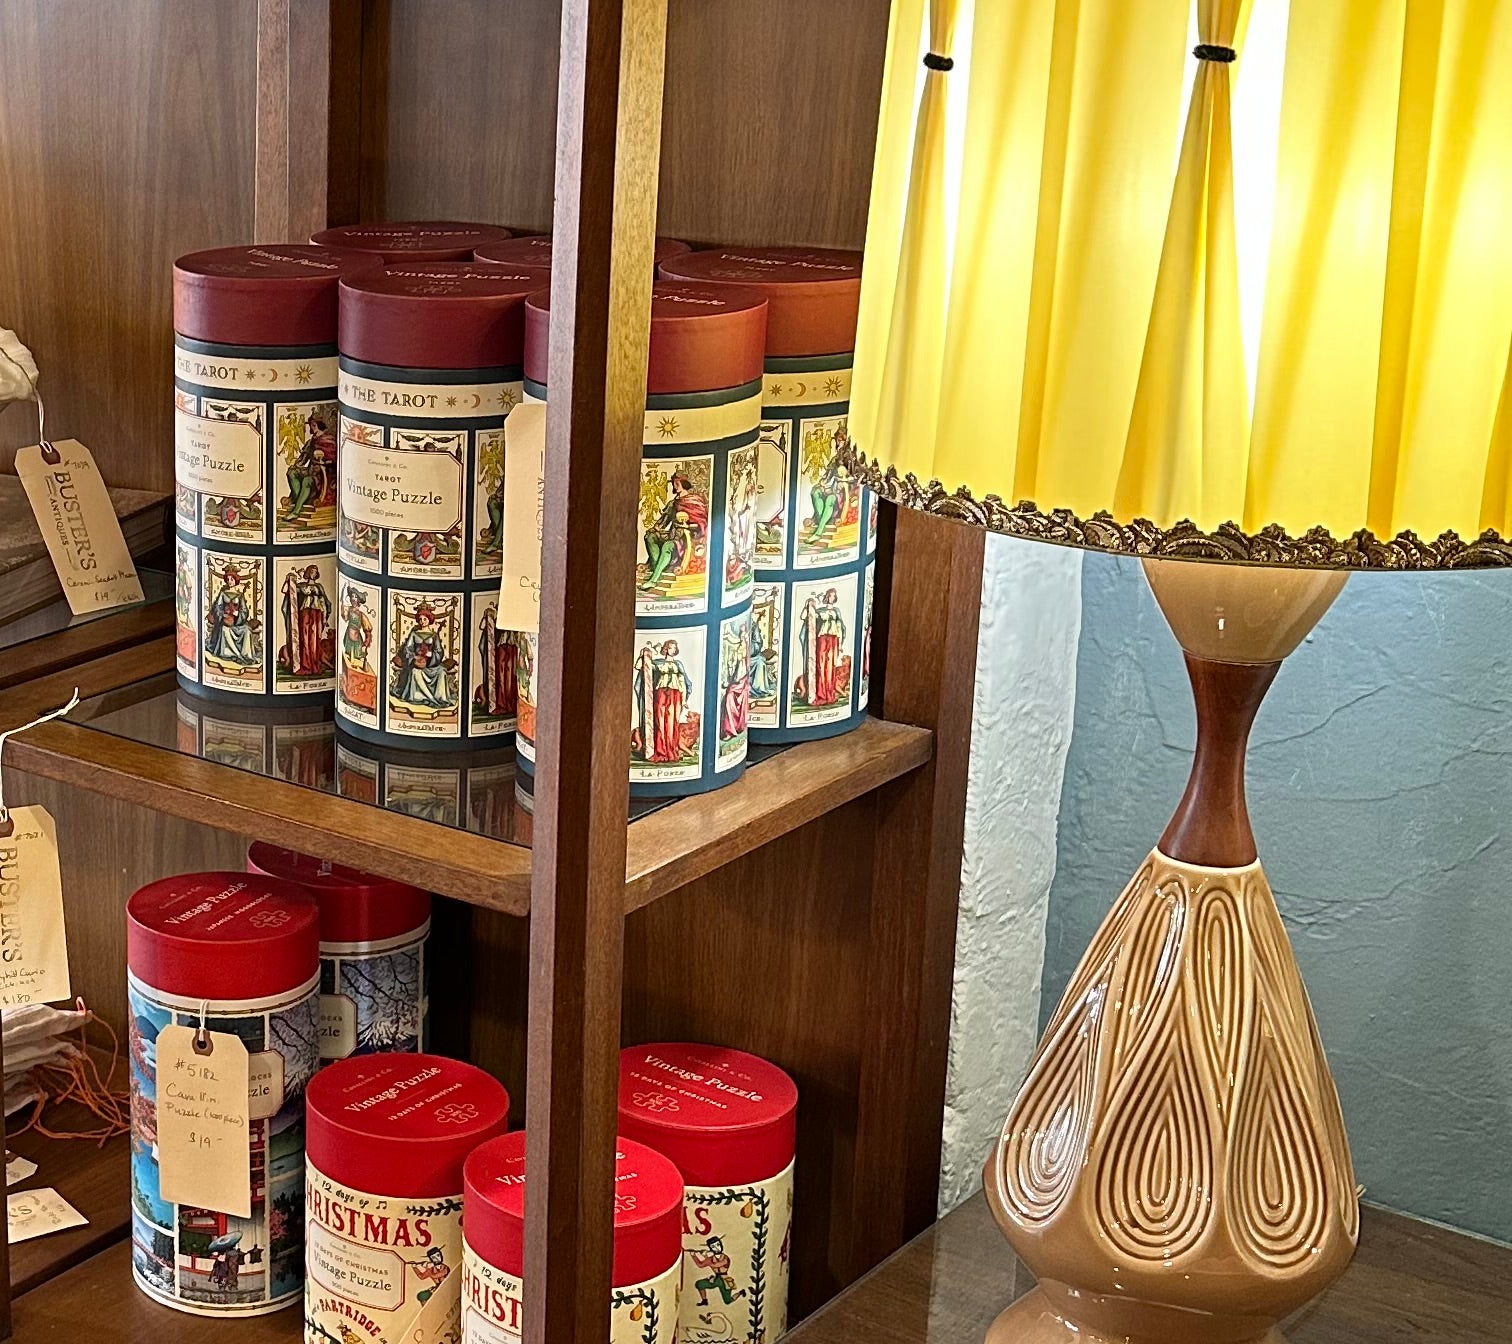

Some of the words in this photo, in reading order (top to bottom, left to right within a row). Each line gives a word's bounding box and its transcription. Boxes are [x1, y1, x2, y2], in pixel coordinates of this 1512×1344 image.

[384, 268, 459, 281] Vintage
[462, 271, 532, 283] Puzzle
[194, 362, 239, 382] TAROT
[351, 385, 376, 403] THE
[381, 390, 439, 409] TAROT
[202, 454, 246, 474] Puzzle
[346, 477, 388, 504] Vintage
[391, 488, 444, 506] Puzzle
[374, 473, 403, 484] TAROT
[49, 498, 70, 546] ANTIQUES
[53, 470, 98, 571] BUSTER'S
[164, 900, 214, 926] Vintage
[208, 881, 248, 905] Puzzle
[320, 1022, 341, 1038] zle
[173, 1058, 220, 1082] #5182
[644, 1054, 705, 1082] Vintage
[704, 1076, 764, 1103] Puzzle
[249, 1083, 271, 1097] zle
[343, 1086, 400, 1114] Vintage
[393, 1065, 442, 1091] Puzzle
[664, 1083, 678, 1093] OF
[678, 1089, 728, 1110] CHRISTMAS
[321, 1180, 333, 1194] 12
[335, 1189, 355, 1204] days
[358, 1197, 370, 1209] of
[306, 1178, 432, 1248] HRISTMAS
[314, 1248, 347, 1280] Vintage
[348, 1270, 392, 1291] Puzzle
[345, 1259, 389, 1276] CHRISTMAS
[481, 1266, 493, 1281] 12
[496, 1276, 518, 1292] days
[463, 1263, 523, 1330] HRIST
[319, 1298, 382, 1337] PARTRIDGE
